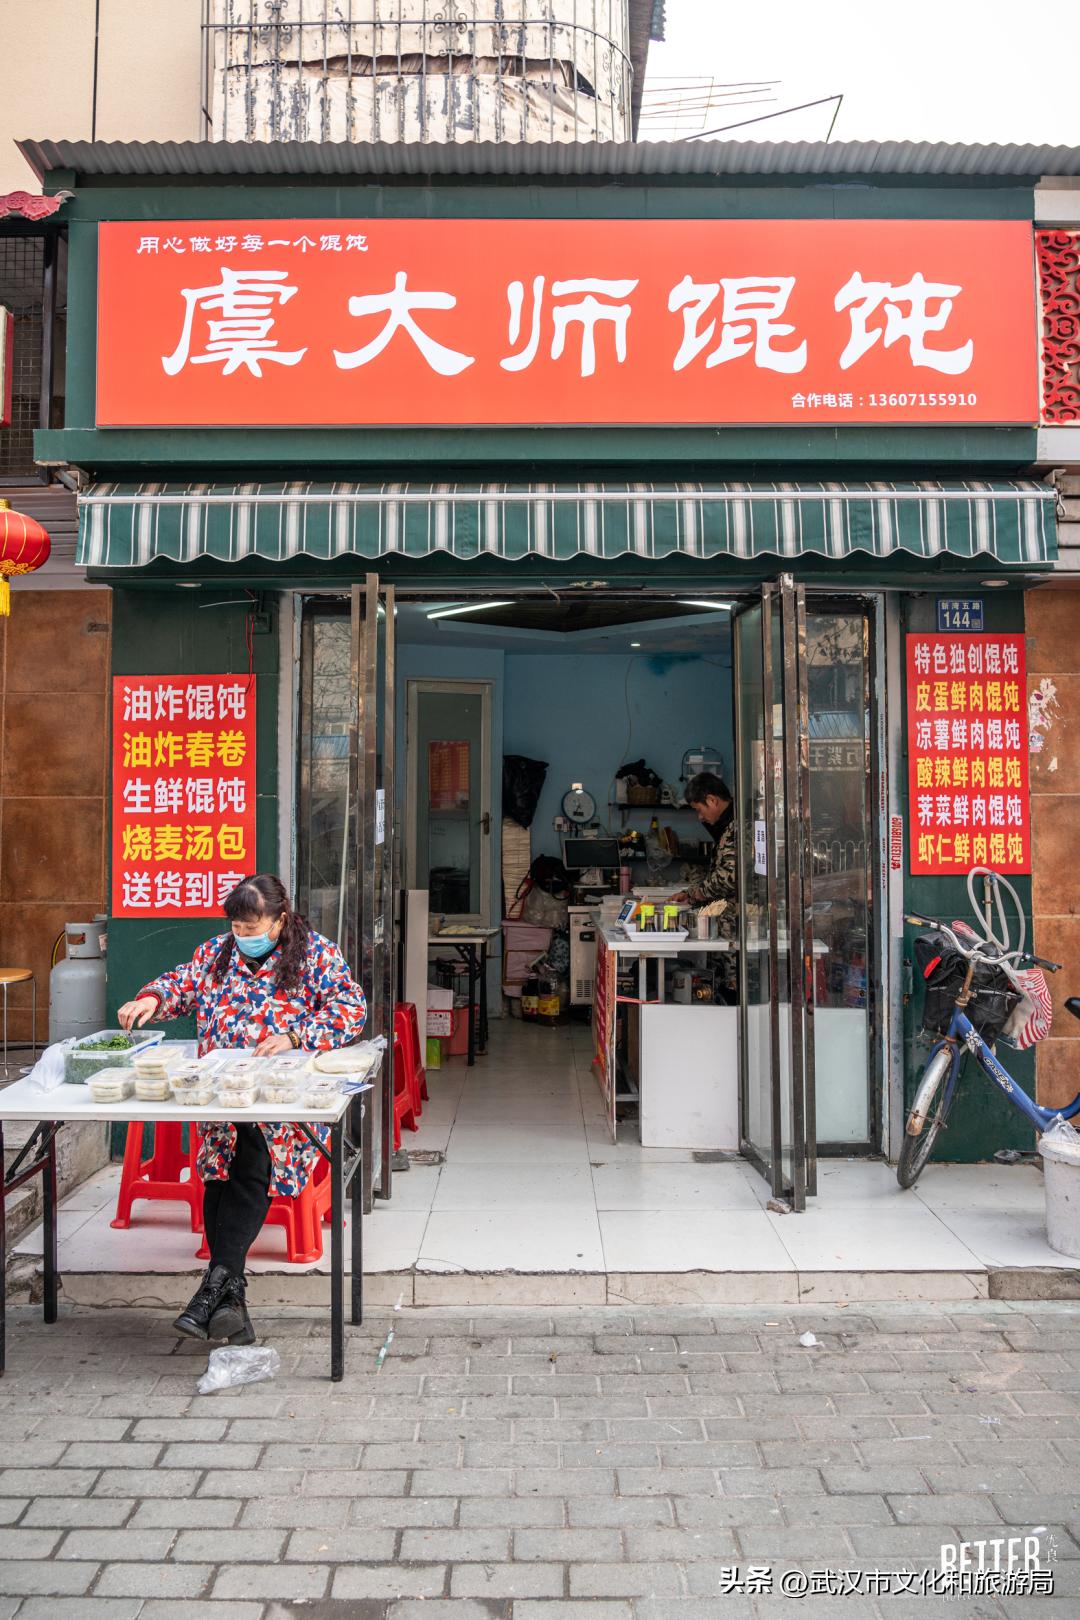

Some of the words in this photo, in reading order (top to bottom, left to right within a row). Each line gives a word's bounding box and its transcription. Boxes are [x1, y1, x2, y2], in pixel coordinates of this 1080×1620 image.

[136, 234, 369, 254] 用心做好每一个馄饨
[161, 266, 974, 378] 虞大师馄饨
[943, 611, 970, 628] 144
[914, 643, 1019, 675] 特色独创馄饨
[123, 684, 246, 721] 油炸馄饨
[915, 680, 1020, 713] 皮蛋鲜肉馄饨
[122, 729, 247, 768] 油炸春卷
[916, 718, 1021, 751] 凉薯鲜肉馄饨
[916, 756, 1022, 789] 酸辣鲜肉馄饨
[122, 776, 247, 815] 生鲜馄饨
[917, 794, 1023, 827] 荠菜鲜肉馄饨
[122, 823, 247, 862] 烧麦汤包
[918, 832, 1024, 865] 虾仁鲜肉馄饨
